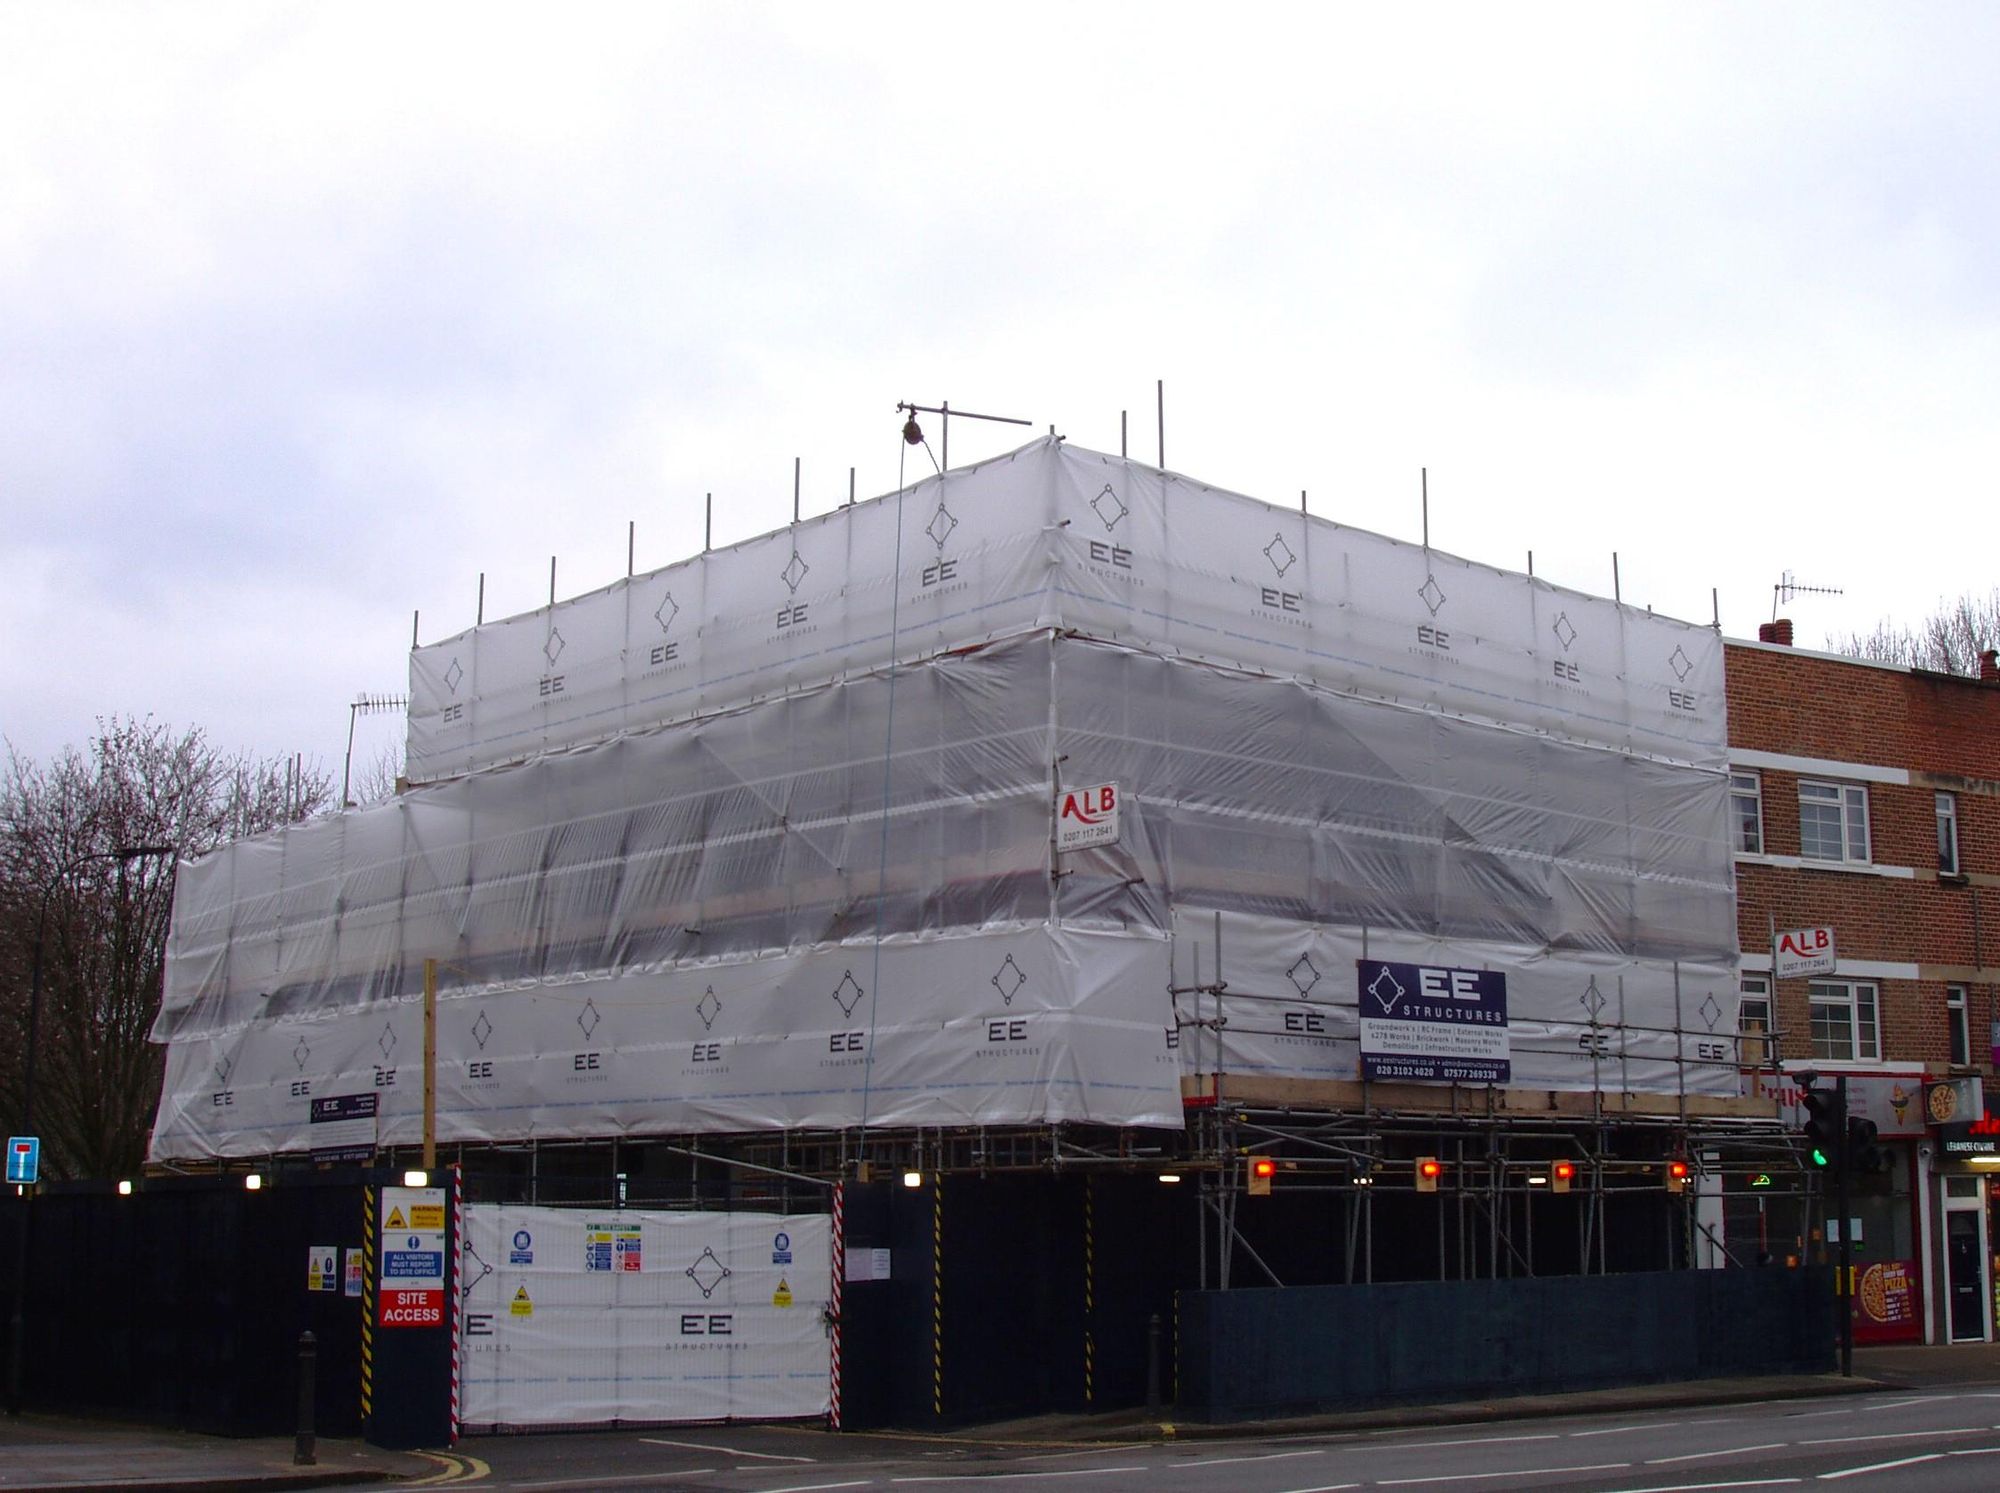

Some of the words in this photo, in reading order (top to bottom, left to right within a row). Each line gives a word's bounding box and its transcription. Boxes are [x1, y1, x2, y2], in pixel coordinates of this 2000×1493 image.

[1090, 540, 1132, 570] EE
[922, 560, 957, 588] EE
[1261, 587, 1301, 613] EE
[776, 603, 809, 629] EE
[1417, 625, 1450, 650] EE
[651, 642, 679, 666] EE
[1554, 660, 1581, 683] EE
[540, 675, 566, 696] EE
[1669, 689, 1697, 712] EE
[443, 703, 463, 723] EE
[1062, 787, 1116, 824] ALB
[1064, 830, 1081, 842] 0207
[1083, 828, 1095, 839] 117
[1780, 929, 1829, 957] ALB
[1419, 968, 1481, 1001] EE
[1285, 1013, 1325, 1033] EE
[1403, 1005, 1502, 1023] STRUCTURES
[988, 1020, 1027, 1042] EE
[830, 1032, 864, 1052] EE
[1698, 1043, 1724, 1060] EE
[575, 1053, 600, 1070] EE
[692, 1044, 721, 1062] EE
[375, 1069, 397, 1087] EE
[469, 1062, 493, 1078] EE
[1376, 1065, 1392, 1075] 020
[1392, 1065, 1413, 1076] 3102
[1414, 1067, 1434, 1077] 4020
[213, 1091, 234, 1106] EE
[292, 1081, 311, 1097] EE
[397, 1292, 428, 1305] SITE
[384, 1309, 440, 1322] ACCESS
[681, 1315, 732, 1335] EE
